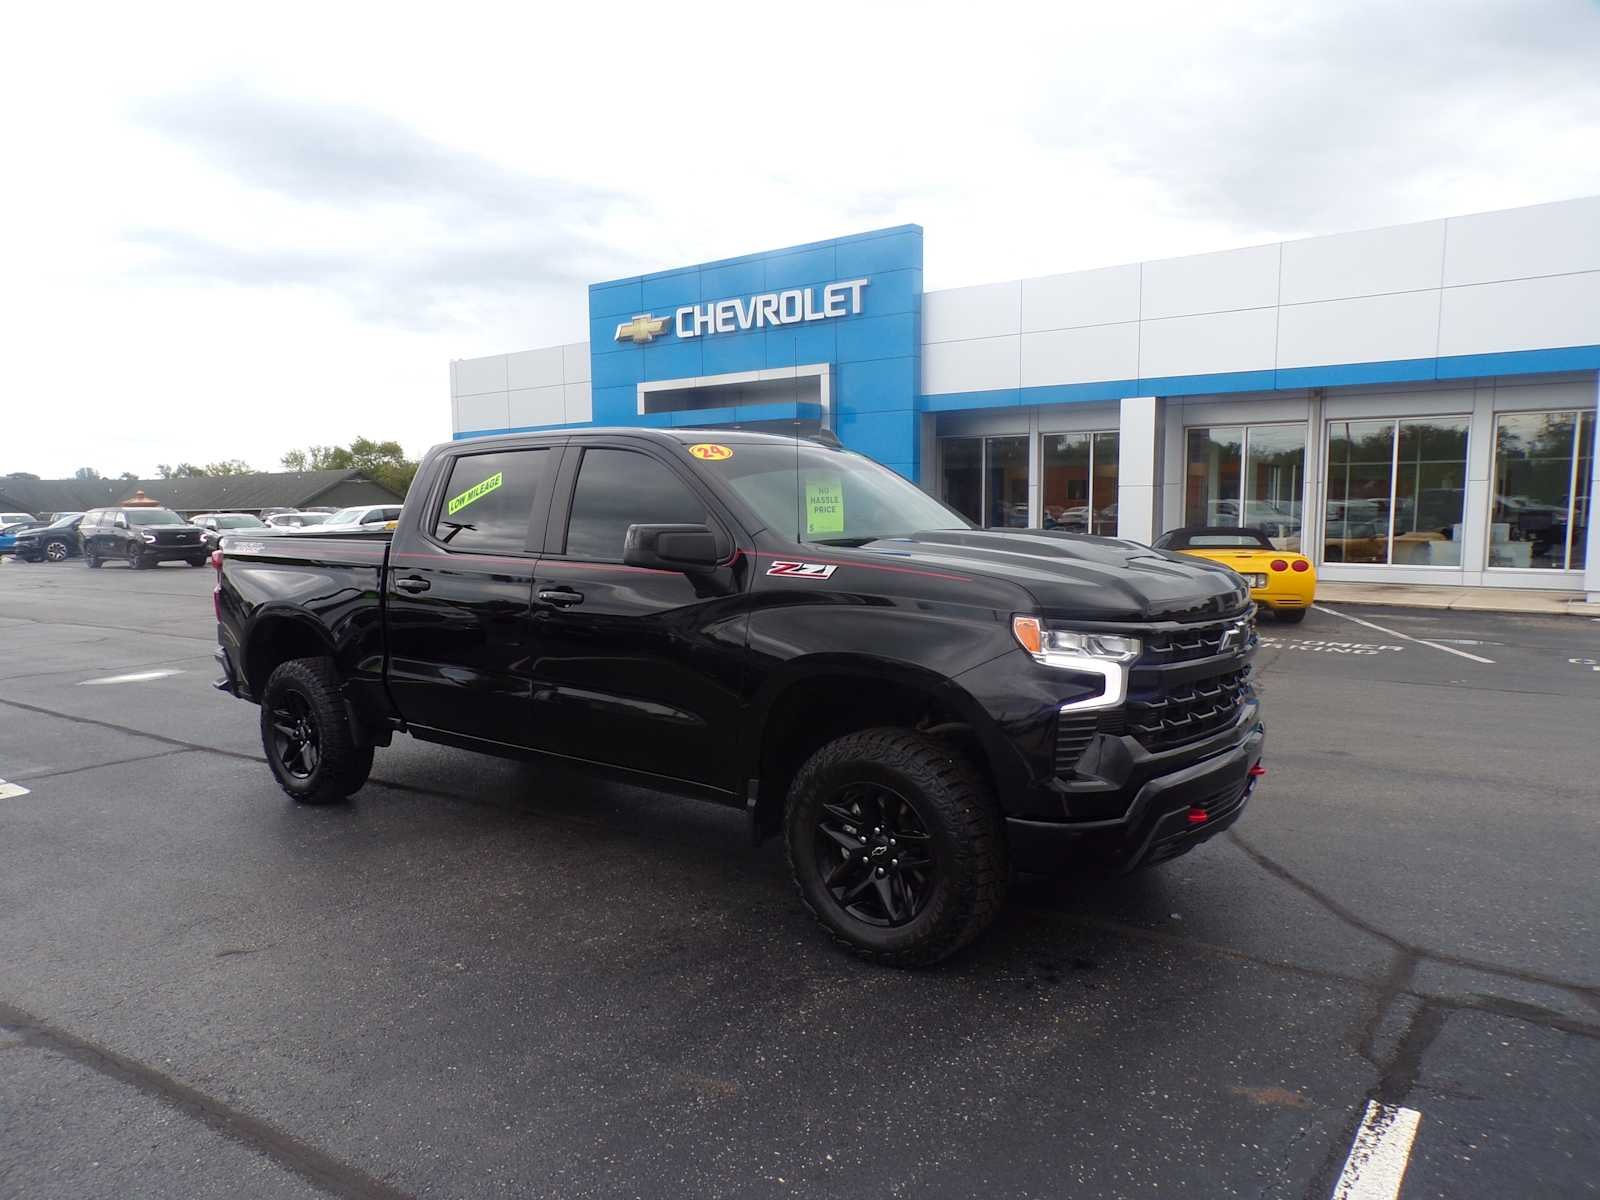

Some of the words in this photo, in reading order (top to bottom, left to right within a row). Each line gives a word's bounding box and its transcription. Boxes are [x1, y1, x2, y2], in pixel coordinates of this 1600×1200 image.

[675, 278, 868, 338] CHEVROLET
[696, 446, 726, 458] 24
[451, 495, 468, 511] LOW
[467, 475, 501, 498] MILEAGE
[810, 496, 841, 504] HASSLE
[814, 505, 838, 513] PRICE
[766, 561, 838, 580] Z71
